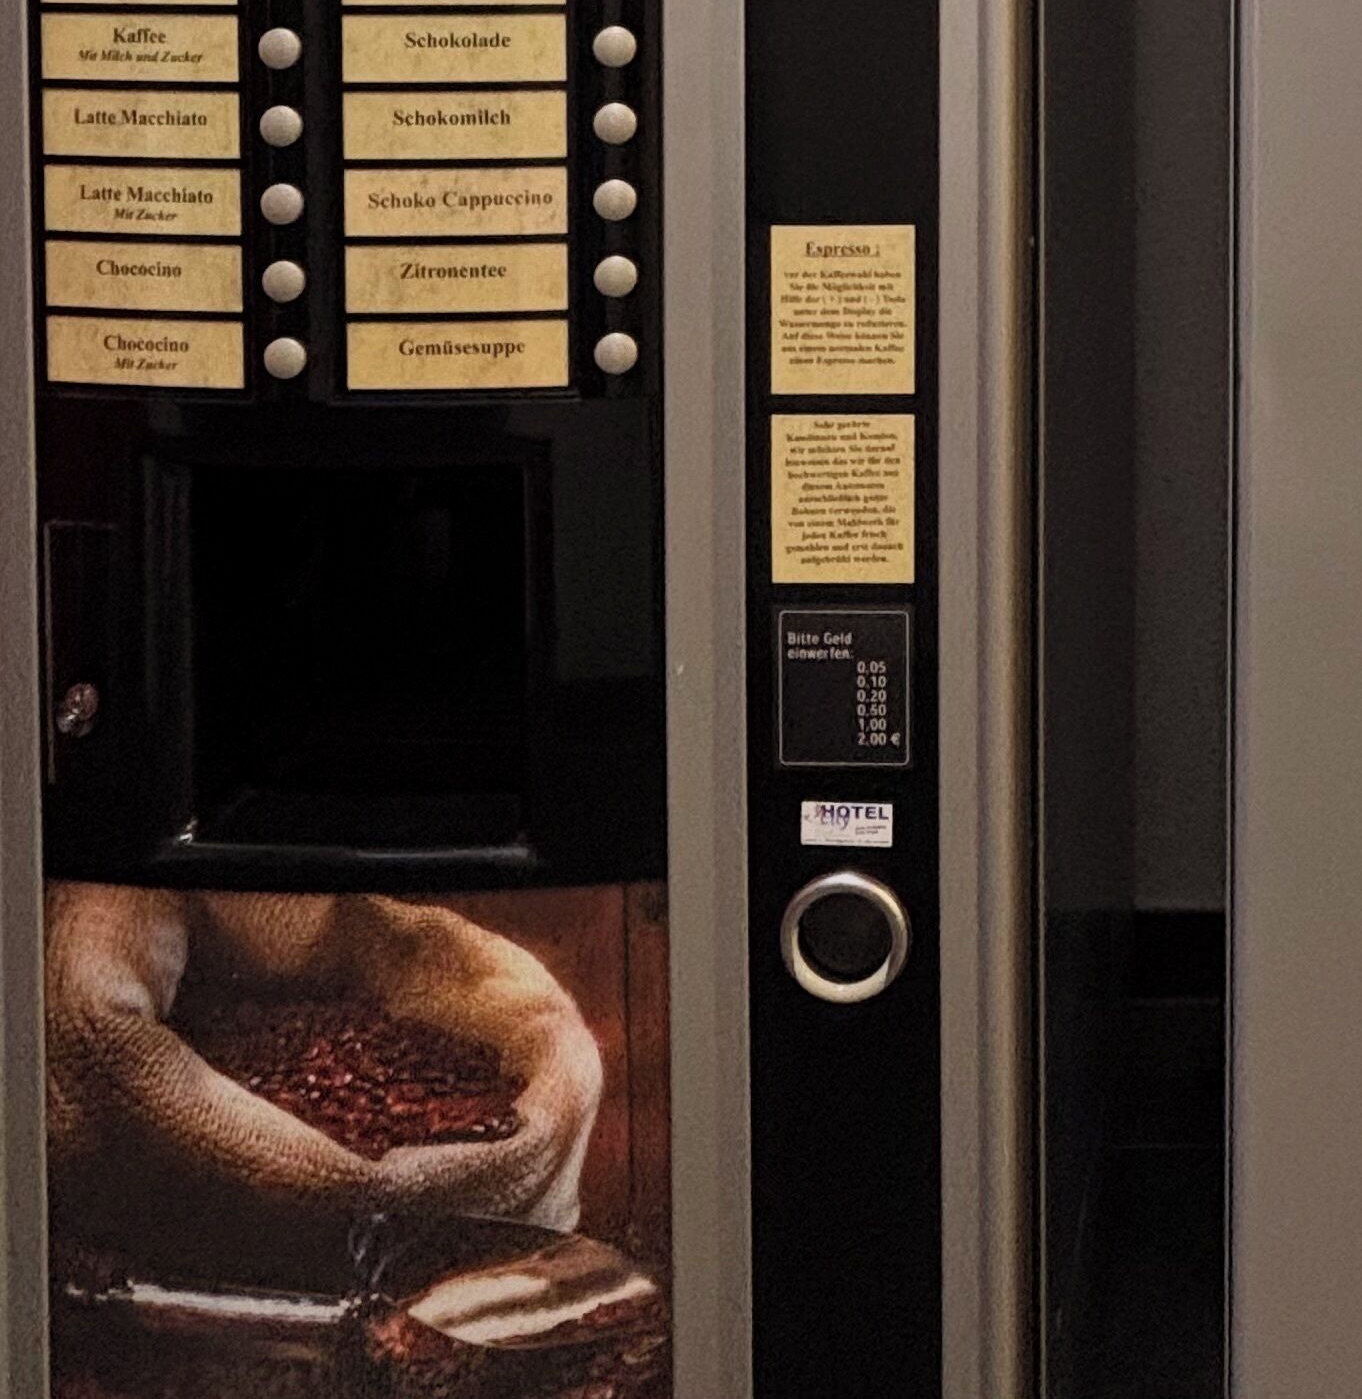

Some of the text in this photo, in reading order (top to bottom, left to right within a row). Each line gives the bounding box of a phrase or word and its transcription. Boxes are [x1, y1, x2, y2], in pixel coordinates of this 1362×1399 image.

[113, 27, 167, 45] Kaffee
[404, 31, 511, 49] Schokolade
[74, 108, 208, 127] Latte Macchiato
[393, 109, 511, 127] Schokomilch
[79, 185, 213, 204] Latte Macchiato
[368, 189, 553, 213] Schoko Cappuccino
[806, 241, 871, 258] Espresso
[96, 259, 182, 278] Chococino
[400, 262, 507, 281] Zitronentee
[103, 335, 190, 354] Chococino
[399, 337, 526, 359] Gemüsesuppe
[787, 631, 853, 645] Bitte Geld
[821, 804, 889, 820] HOTEL
